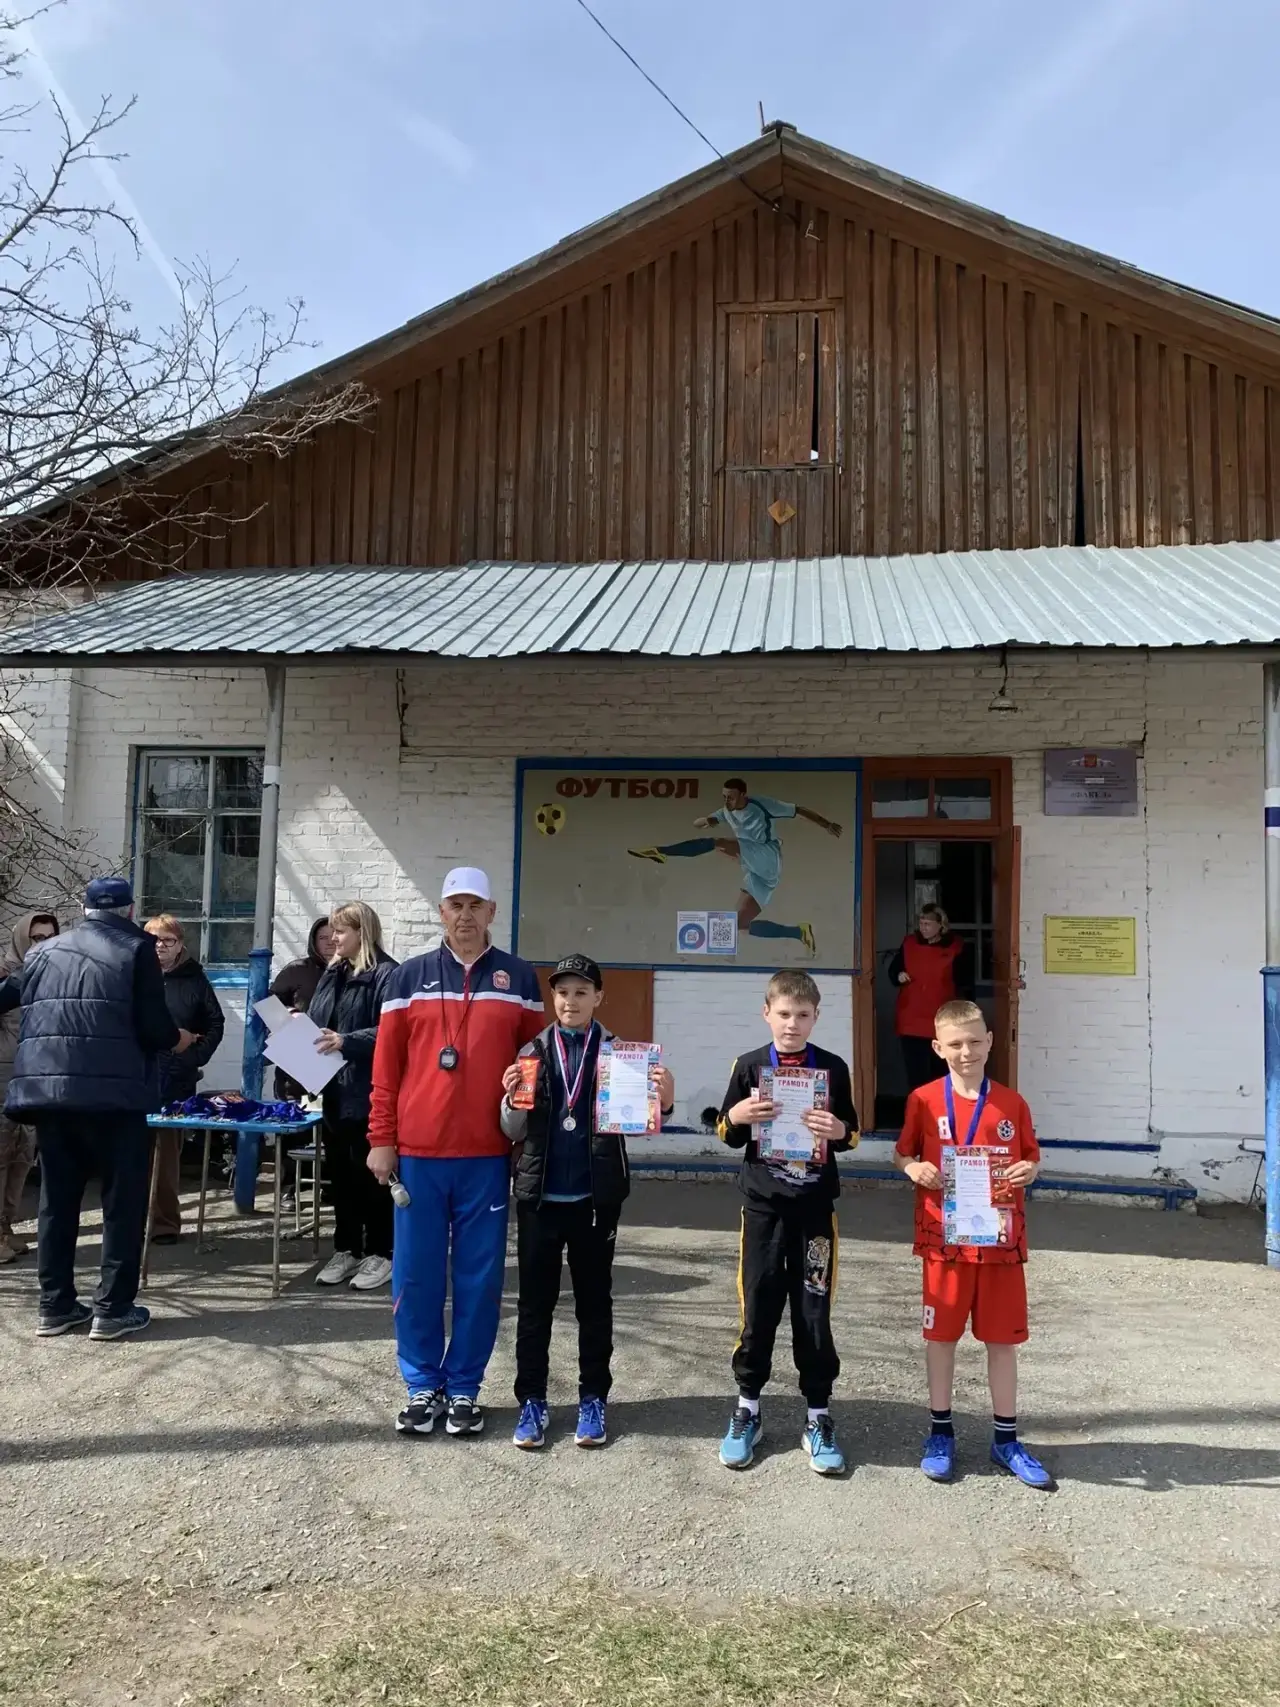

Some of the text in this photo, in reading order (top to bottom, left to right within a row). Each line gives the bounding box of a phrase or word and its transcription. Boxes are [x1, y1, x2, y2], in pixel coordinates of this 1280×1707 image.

[555, 777, 699, 799] ФУТБОЛ
[557, 958, 592, 972] BEST
[615, 1052, 645, 1060] ГРАМОТА
[778, 1079, 809, 1089] ГРАМОТА
[937, 1116, 952, 1140] 8
[923, 1305, 935, 1330] 8
